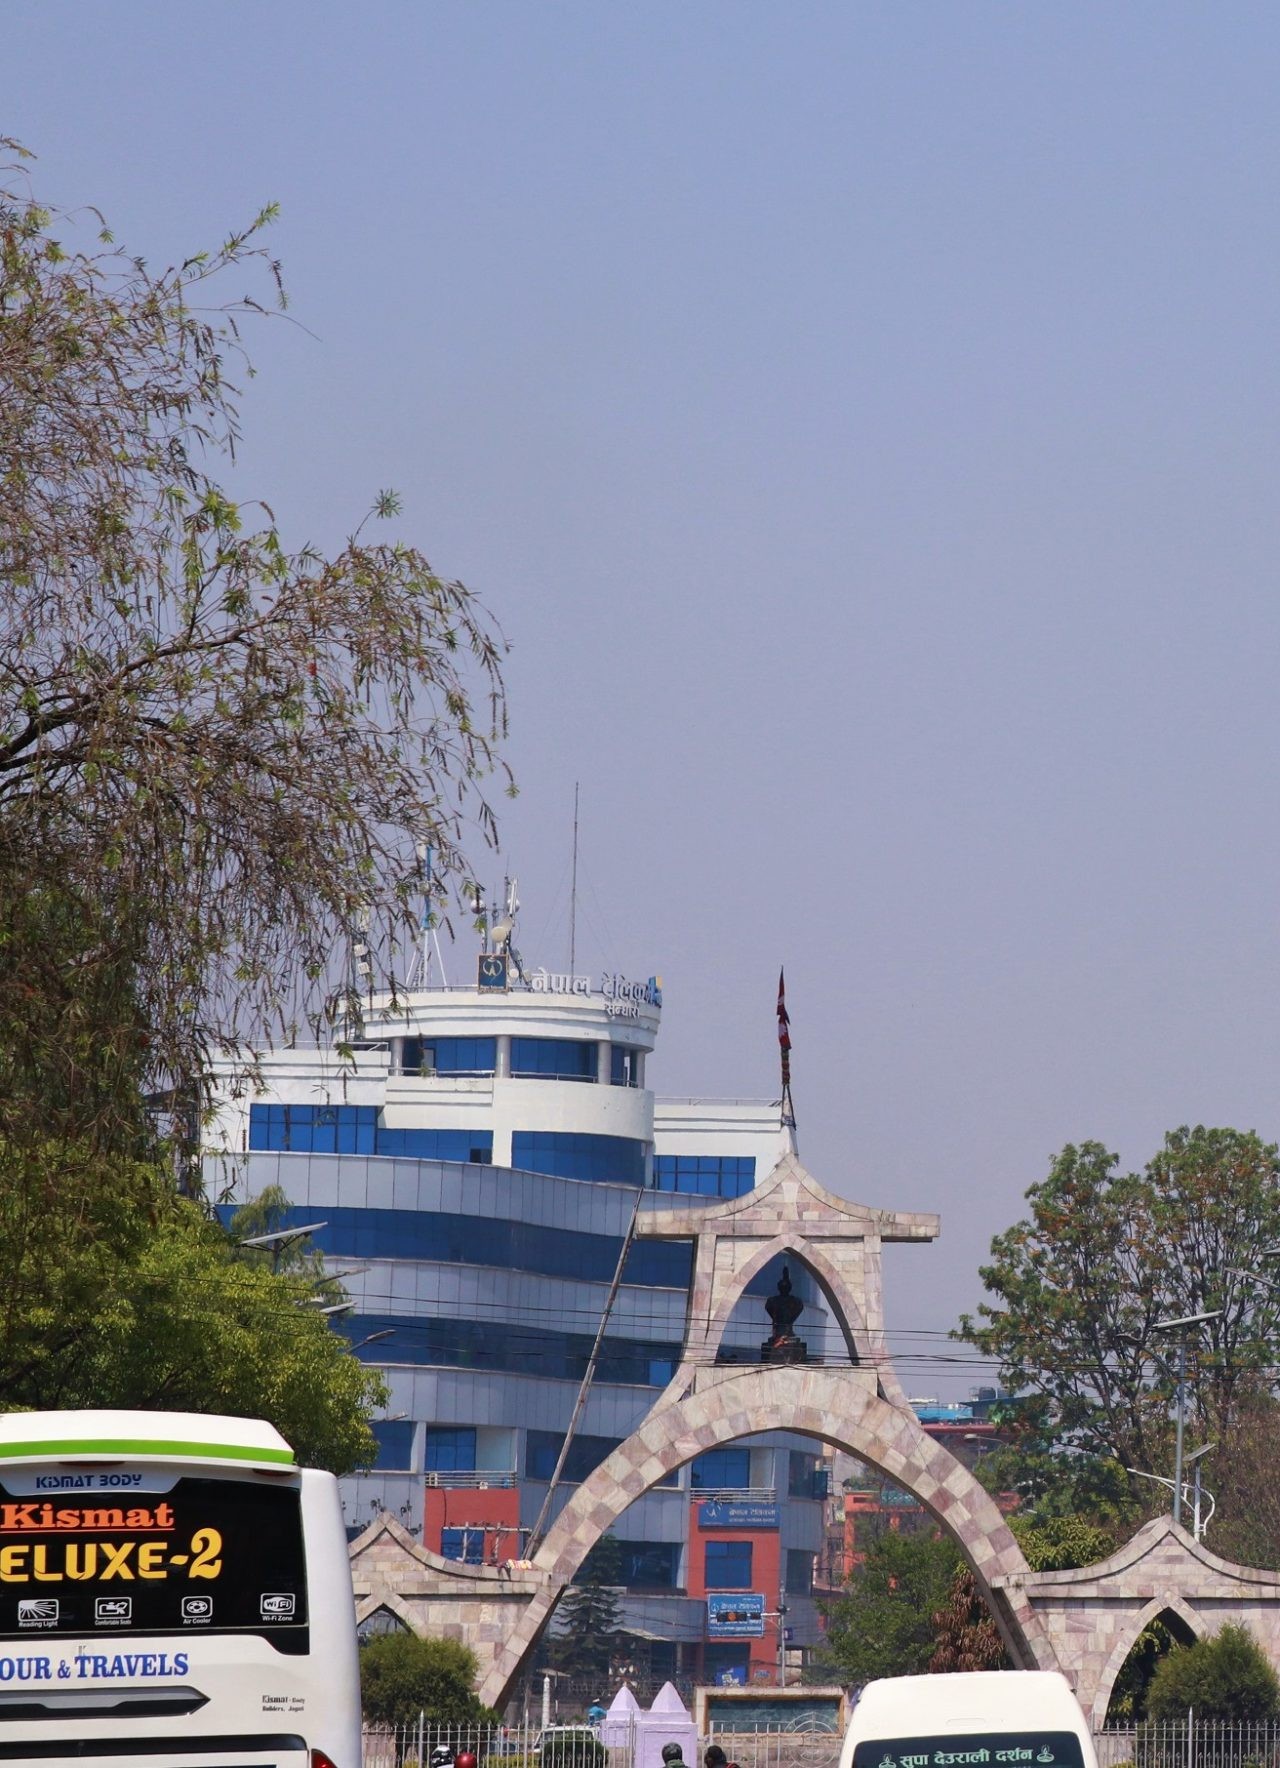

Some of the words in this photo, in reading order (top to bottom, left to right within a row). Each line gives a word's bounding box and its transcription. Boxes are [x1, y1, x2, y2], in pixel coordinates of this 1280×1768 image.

[532, 967, 592, 997] नेपाल
[1, 1503, 174, 1529] Kismat
[57, 1660, 71, 1678] &
[75, 1653, 189, 1678] TRAVELS
[900, 1754, 929, 1768] सुपा
[934, 1748, 990, 1765] देउराली
[995, 1746, 1033, 1762] दर्शन
